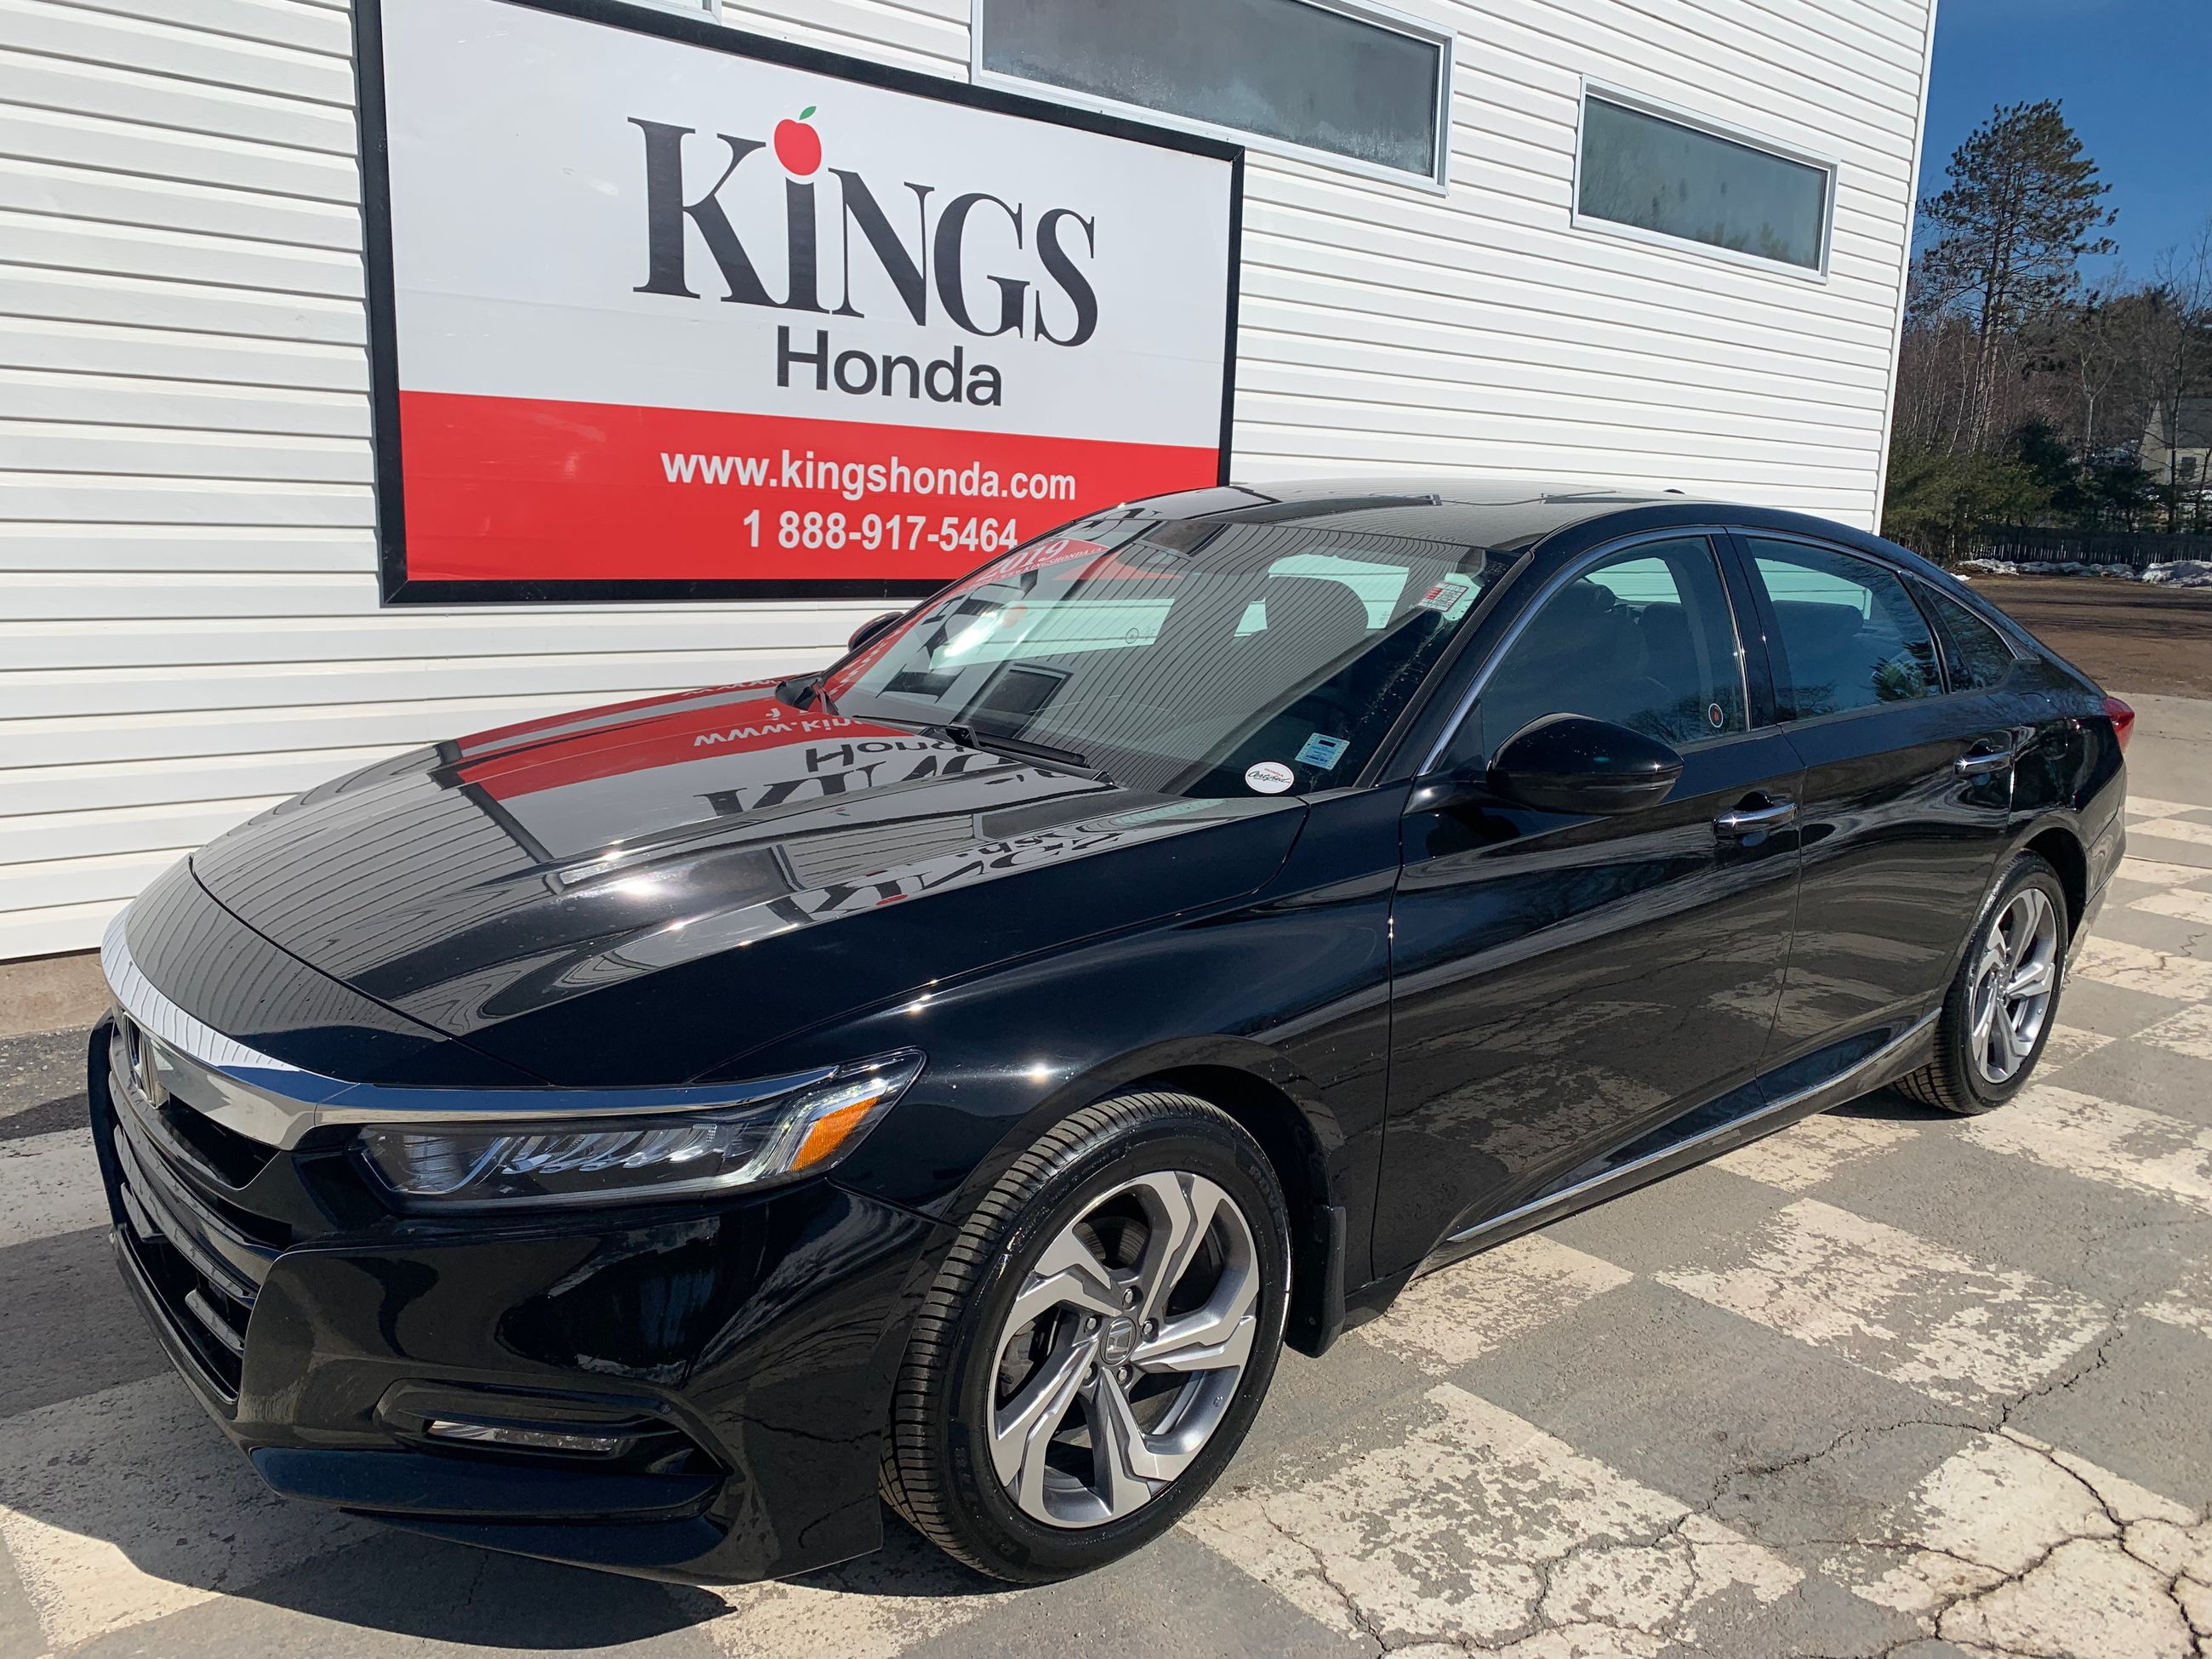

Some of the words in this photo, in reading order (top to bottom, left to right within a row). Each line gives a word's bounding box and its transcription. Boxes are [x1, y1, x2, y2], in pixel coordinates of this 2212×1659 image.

[776, 325, 1003, 407] Honda
[660, 448, 1076, 501] www.kingshonda.com
[743, 509, 761, 548] 1
[778, 510, 1018, 552] 888-917-5464
[976, 539, 1070, 584] 2019
